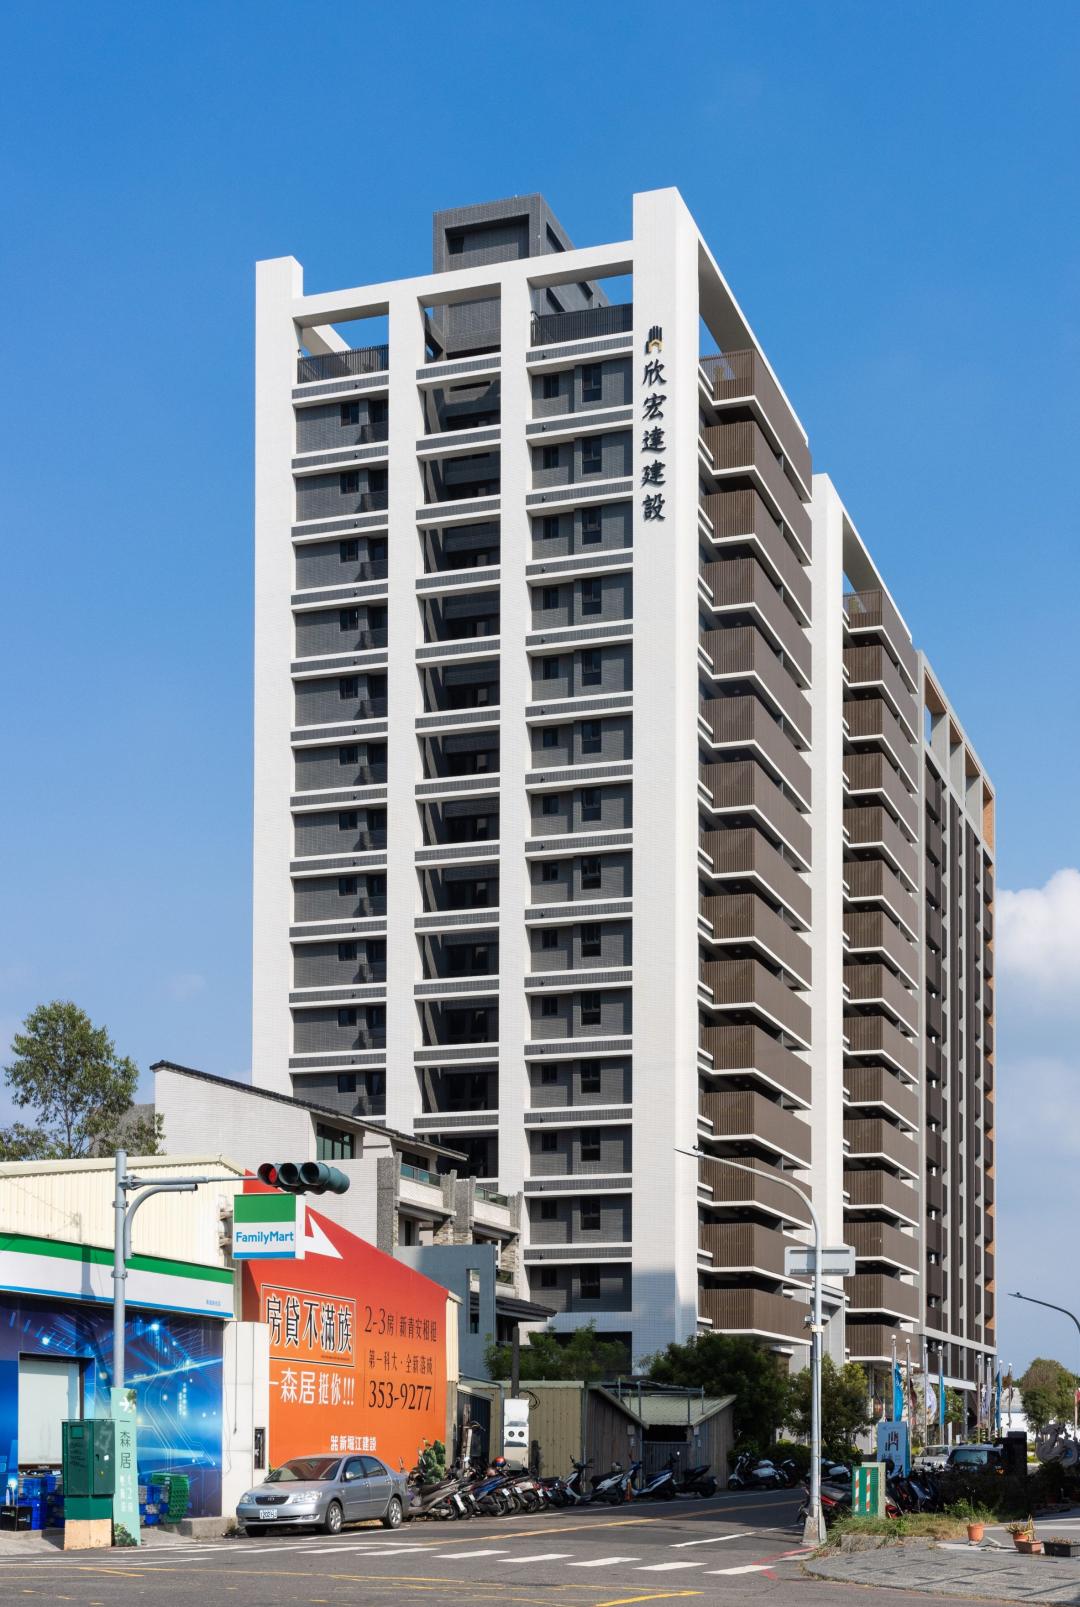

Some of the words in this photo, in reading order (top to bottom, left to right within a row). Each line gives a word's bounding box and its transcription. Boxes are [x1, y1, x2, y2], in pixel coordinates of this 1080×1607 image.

[641, 358, 667, 521] 欣宏達建設
[236, 1231, 294, 1245] FamilyMart
[266, 1293, 353, 1353] 房貸不滿族
[368, 1379, 433, 1411] 353-9277
[119, 1419, 131, 1470] 一森居
